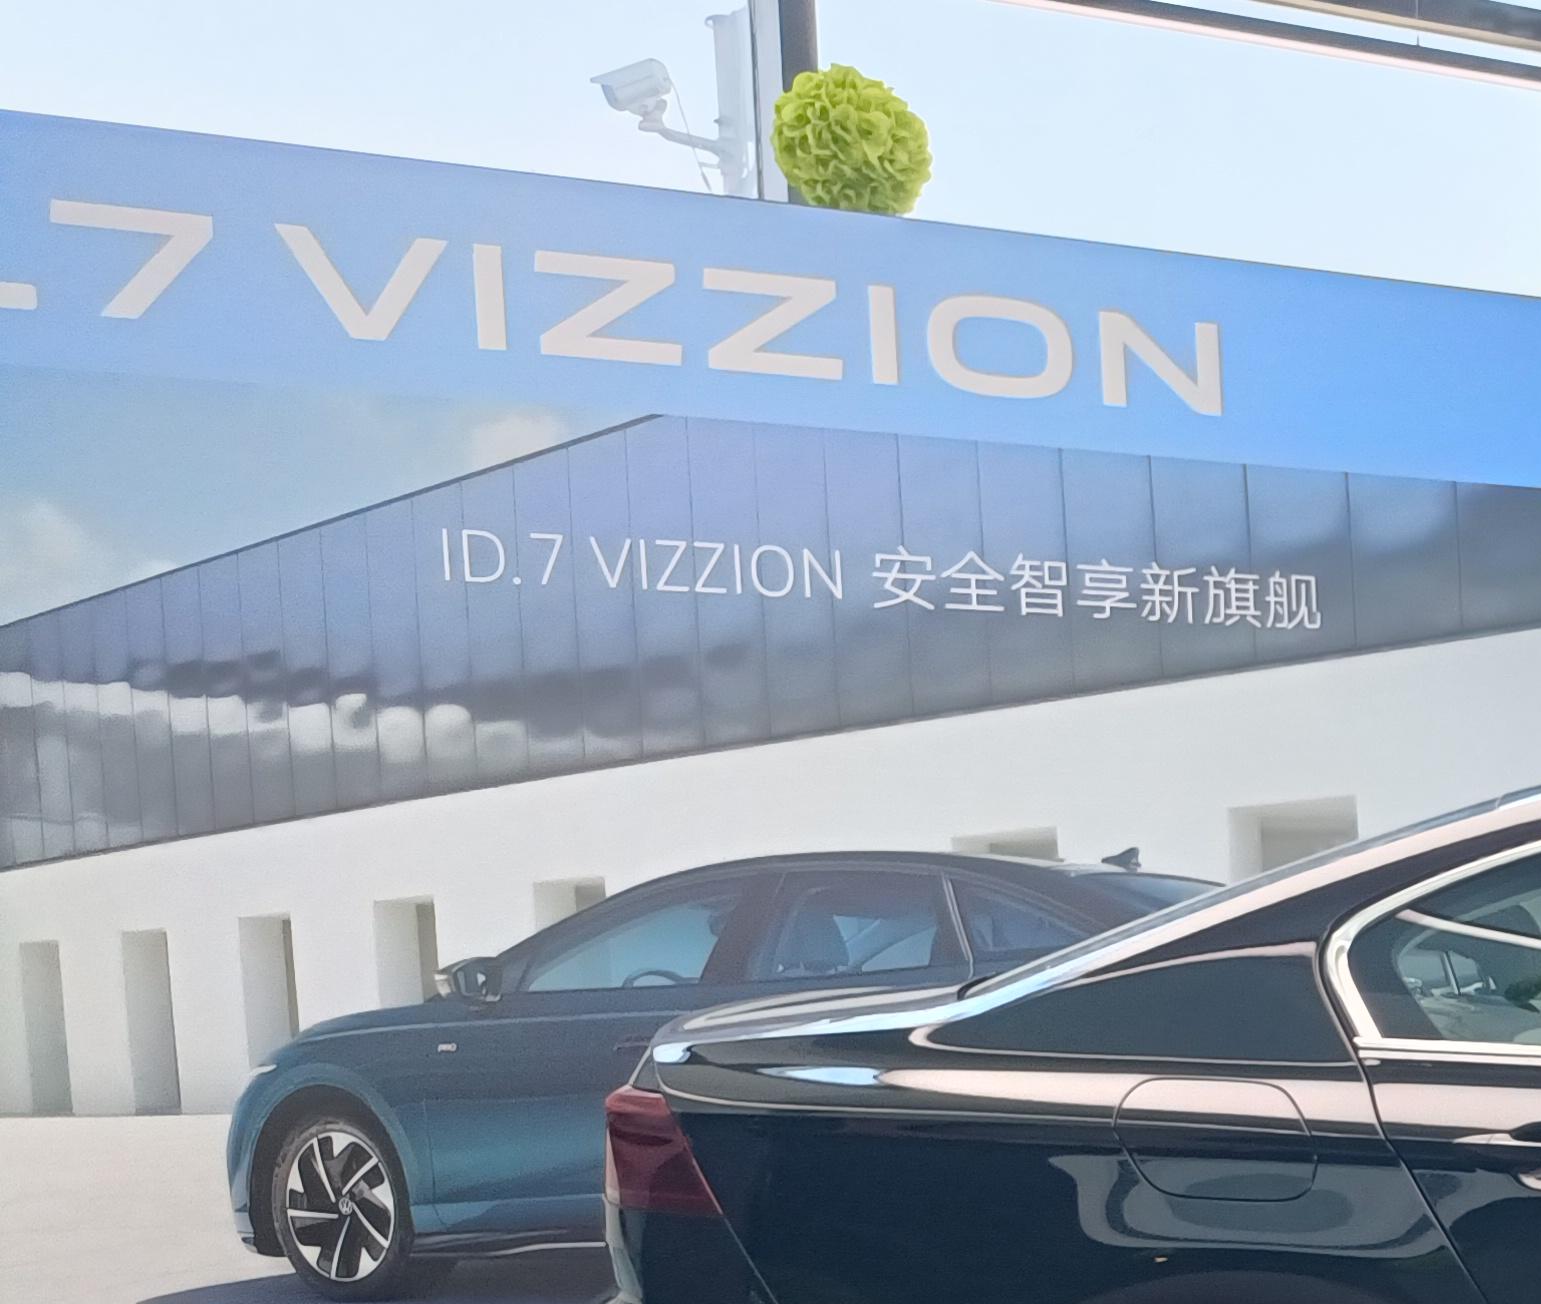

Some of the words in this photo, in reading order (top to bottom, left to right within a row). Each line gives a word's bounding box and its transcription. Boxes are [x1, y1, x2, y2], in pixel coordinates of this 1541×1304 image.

[273, 222, 1223, 416] VIZZION
[440, 527, 565, 588] ID.7
[590, 534, 846, 600] VIZZION
[870, 545, 1323, 633] 安全智享新旗舰
